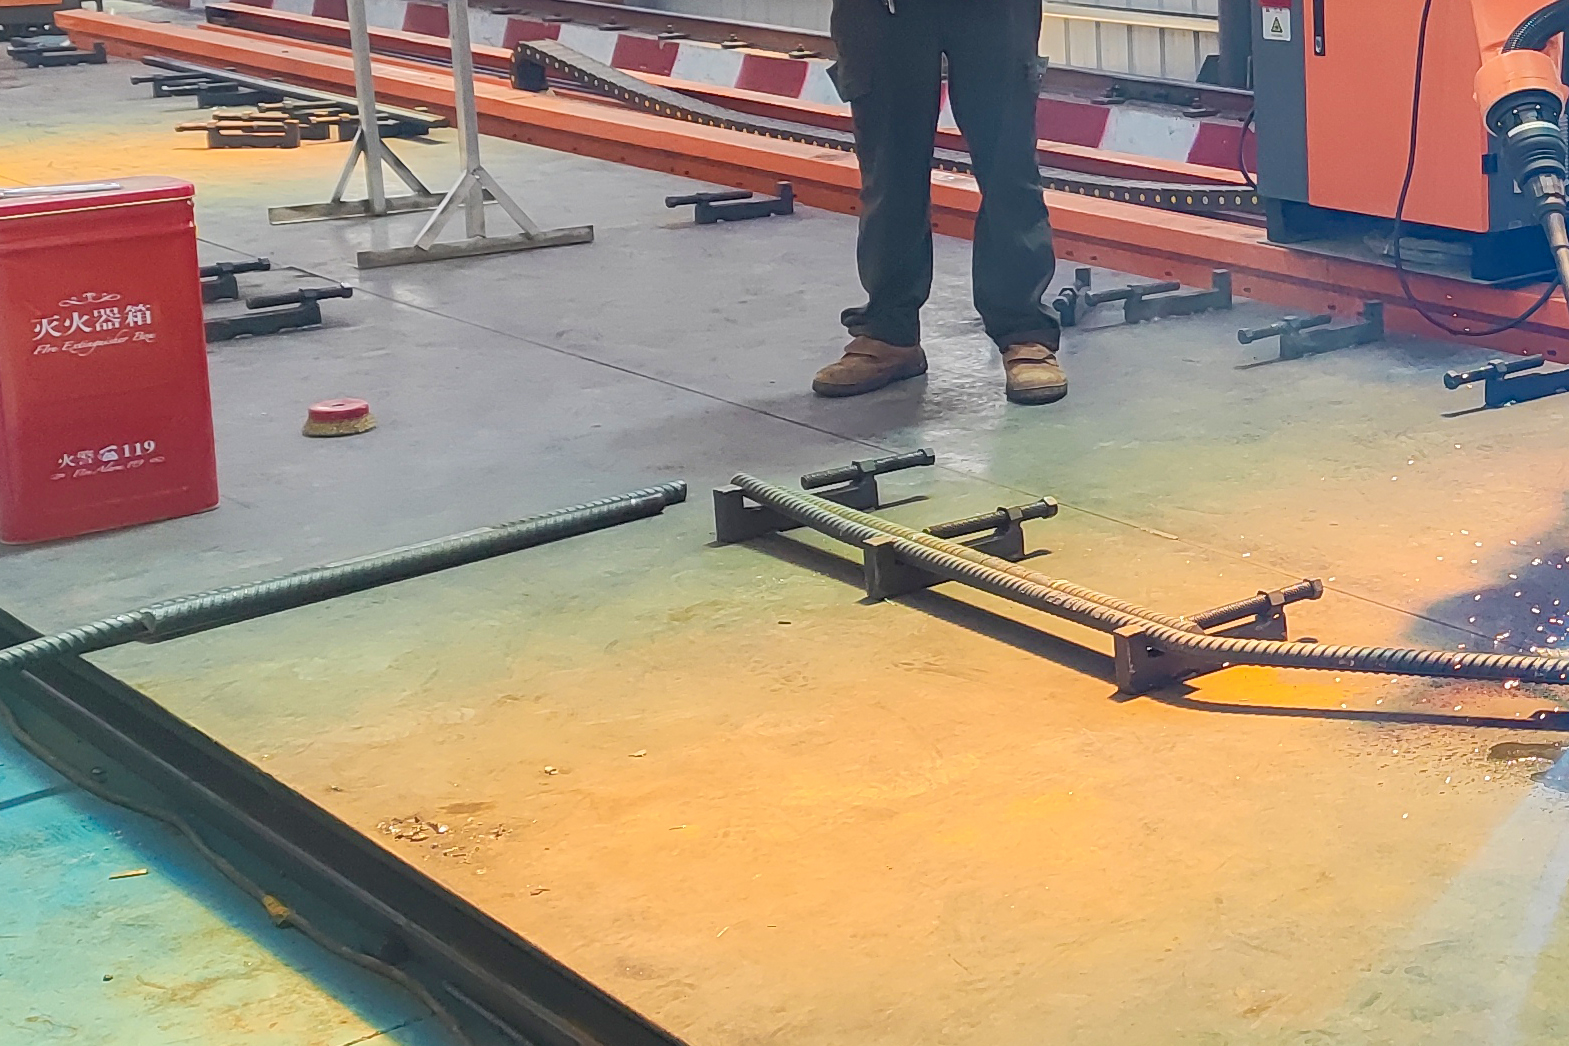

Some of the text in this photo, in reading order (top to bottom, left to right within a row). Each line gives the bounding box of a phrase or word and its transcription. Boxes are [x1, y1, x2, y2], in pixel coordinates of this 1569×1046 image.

[31, 303, 152, 342] 灭火器箱
[123, 440, 155, 458] 119
